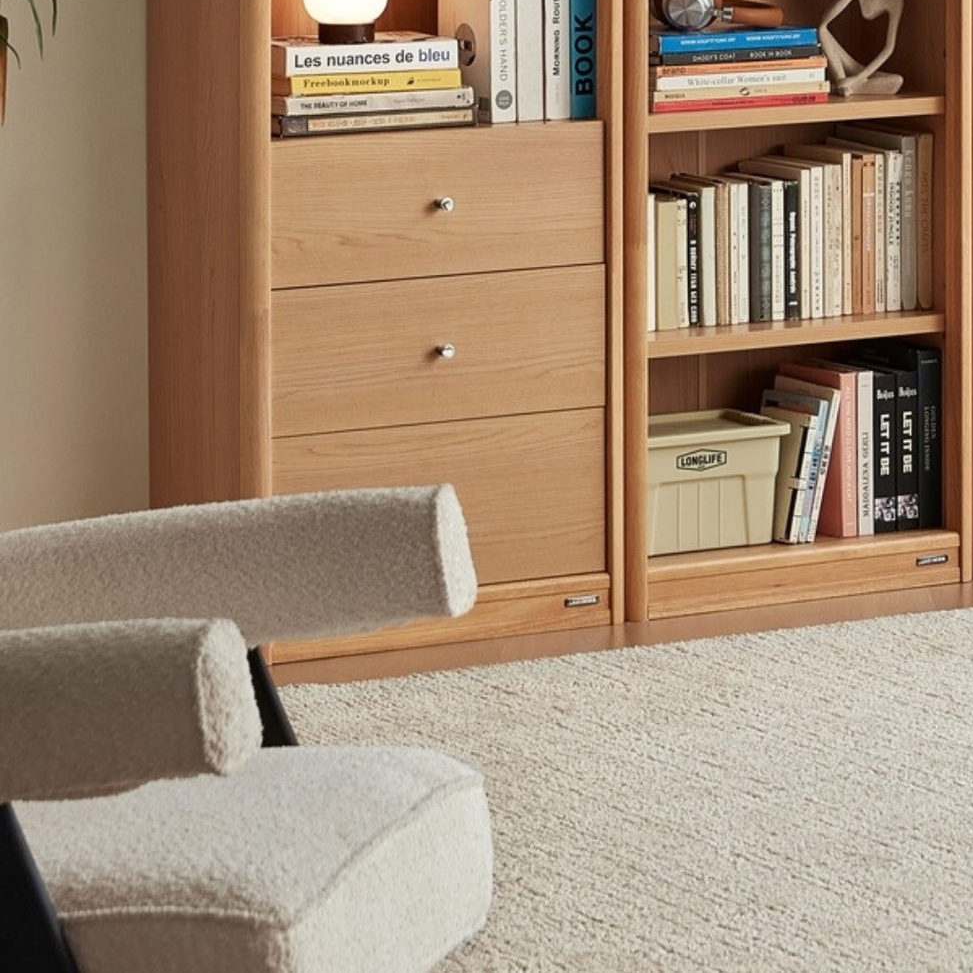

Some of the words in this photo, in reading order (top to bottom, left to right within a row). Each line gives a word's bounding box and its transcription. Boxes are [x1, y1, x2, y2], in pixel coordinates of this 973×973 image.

[294, 54, 322, 69] Les
[327, 52, 390, 67] nuances
[395, 49, 414, 63] de
[418, 48, 450, 63] bleu
[553, 29, 561, 76] MORNING
[574, 13, 594, 96] BOOK
[717, 52, 736, 61] COAT
[749, 50, 767, 59] BOOK
[775, 49, 792, 57] BOOK
[499, 49, 509, 82] HAND
[303, 77, 390, 89] Freebookmockup
[687, 75, 736, 87] White-collar
[737, 74, 771, 84] Women's
[300, 102, 313, 110] THE
[313, 101, 338, 110] BEAUTY
[338, 100, 348, 108] OF
[349, 99, 368, 107] HOME
[880, 413, 890, 439] LET
[903, 411, 912, 437] LET
[880, 441, 890, 455] IT
[903, 438, 912, 452] IT
[680, 453, 723, 466] LONGLIFE
[880, 456, 890, 476] BE
[903, 454, 912, 474] BE
